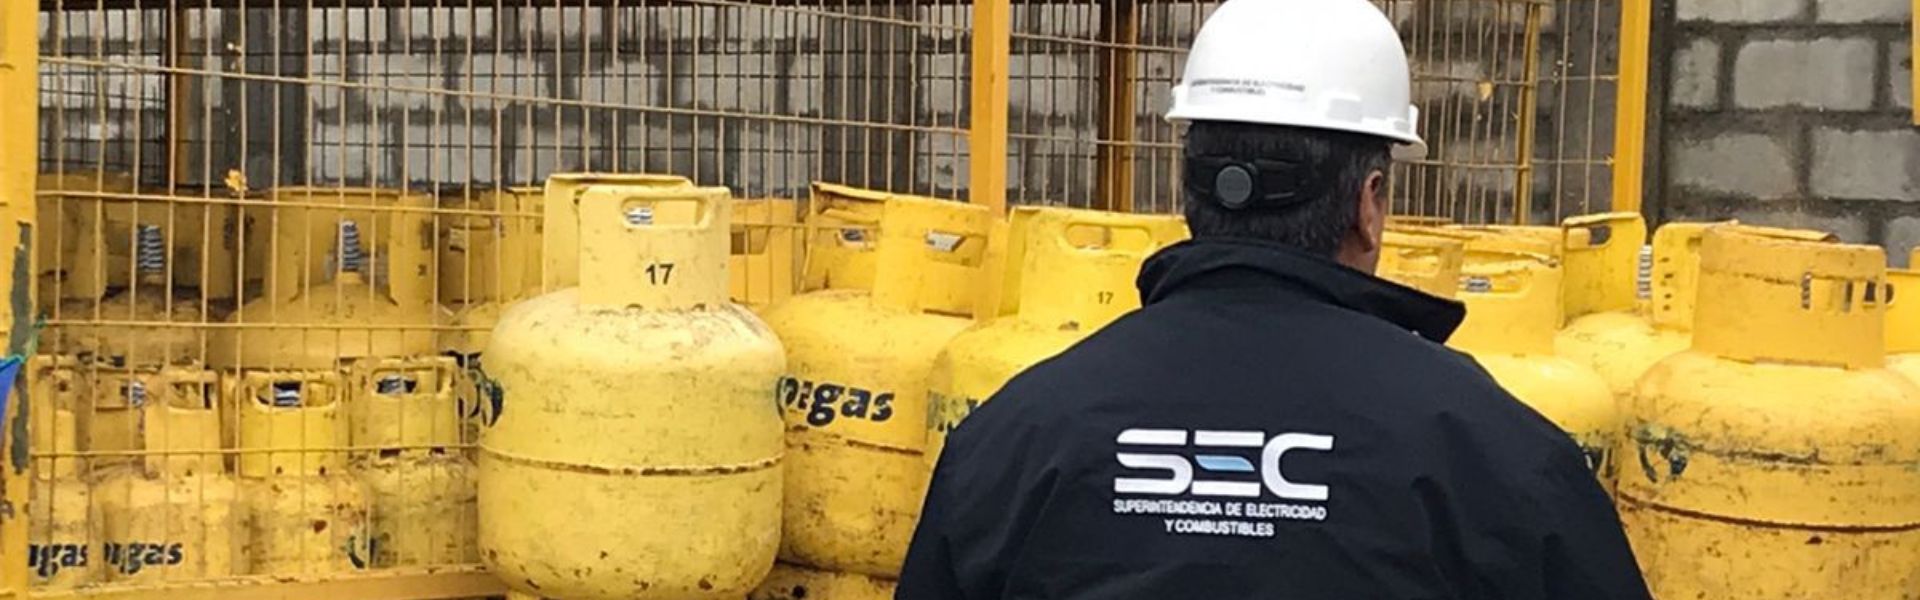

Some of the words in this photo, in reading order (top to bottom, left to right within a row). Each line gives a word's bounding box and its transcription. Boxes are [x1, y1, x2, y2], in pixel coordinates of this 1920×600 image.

[645, 263, 675, 285] 17
[1098, 291, 1114, 304] 17
[1114, 428, 1334, 500] SEC
[1113, 500, 1222, 515] SUPERINTENDENCIA
[1225, 502, 1242, 516] DE
[1245, 503, 1327, 520] ELECTRICIDAD
[1164, 519, 1173, 532] Y
[1174, 519, 1274, 536] COMBUSTIBLES
